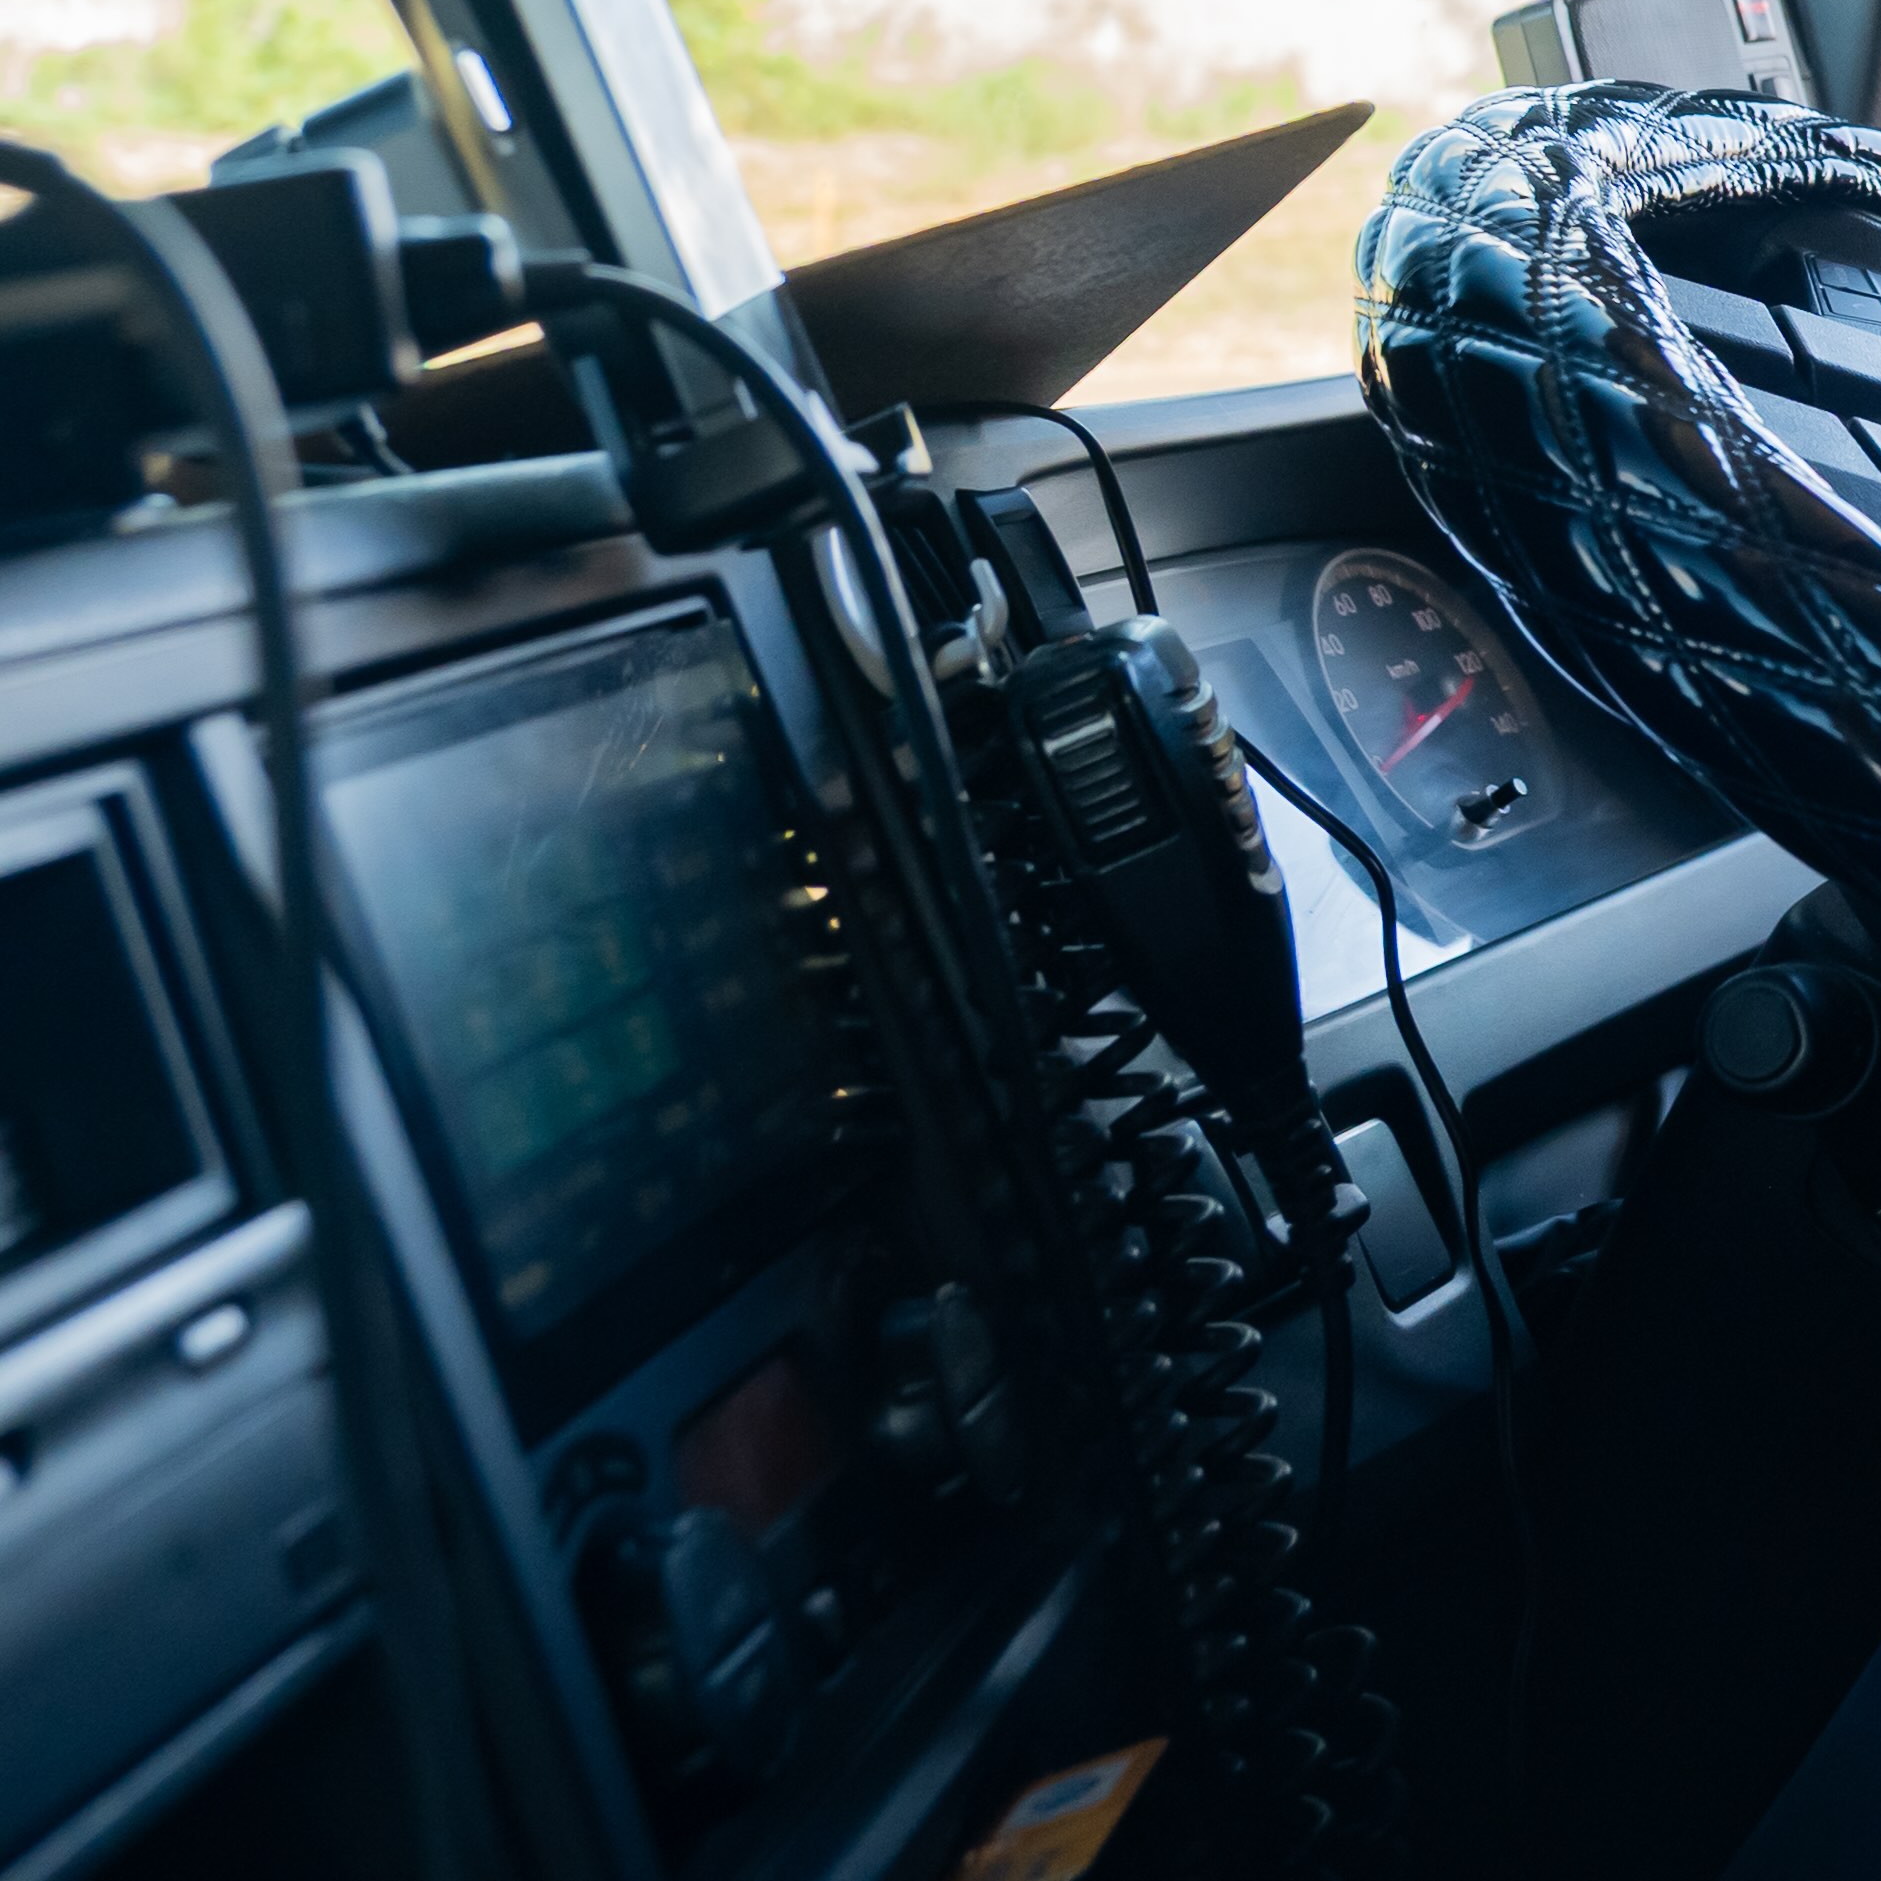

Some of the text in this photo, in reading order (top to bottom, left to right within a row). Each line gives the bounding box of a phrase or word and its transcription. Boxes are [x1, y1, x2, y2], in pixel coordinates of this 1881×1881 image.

[1333, 592, 1358, 617] 60
[1368, 583, 1393, 607] 80
[1411, 607, 1442, 632] 100
[1320, 633, 1345, 657] 40
[1454, 650, 1483, 675] 120
[1334, 687, 1360, 713] 20
